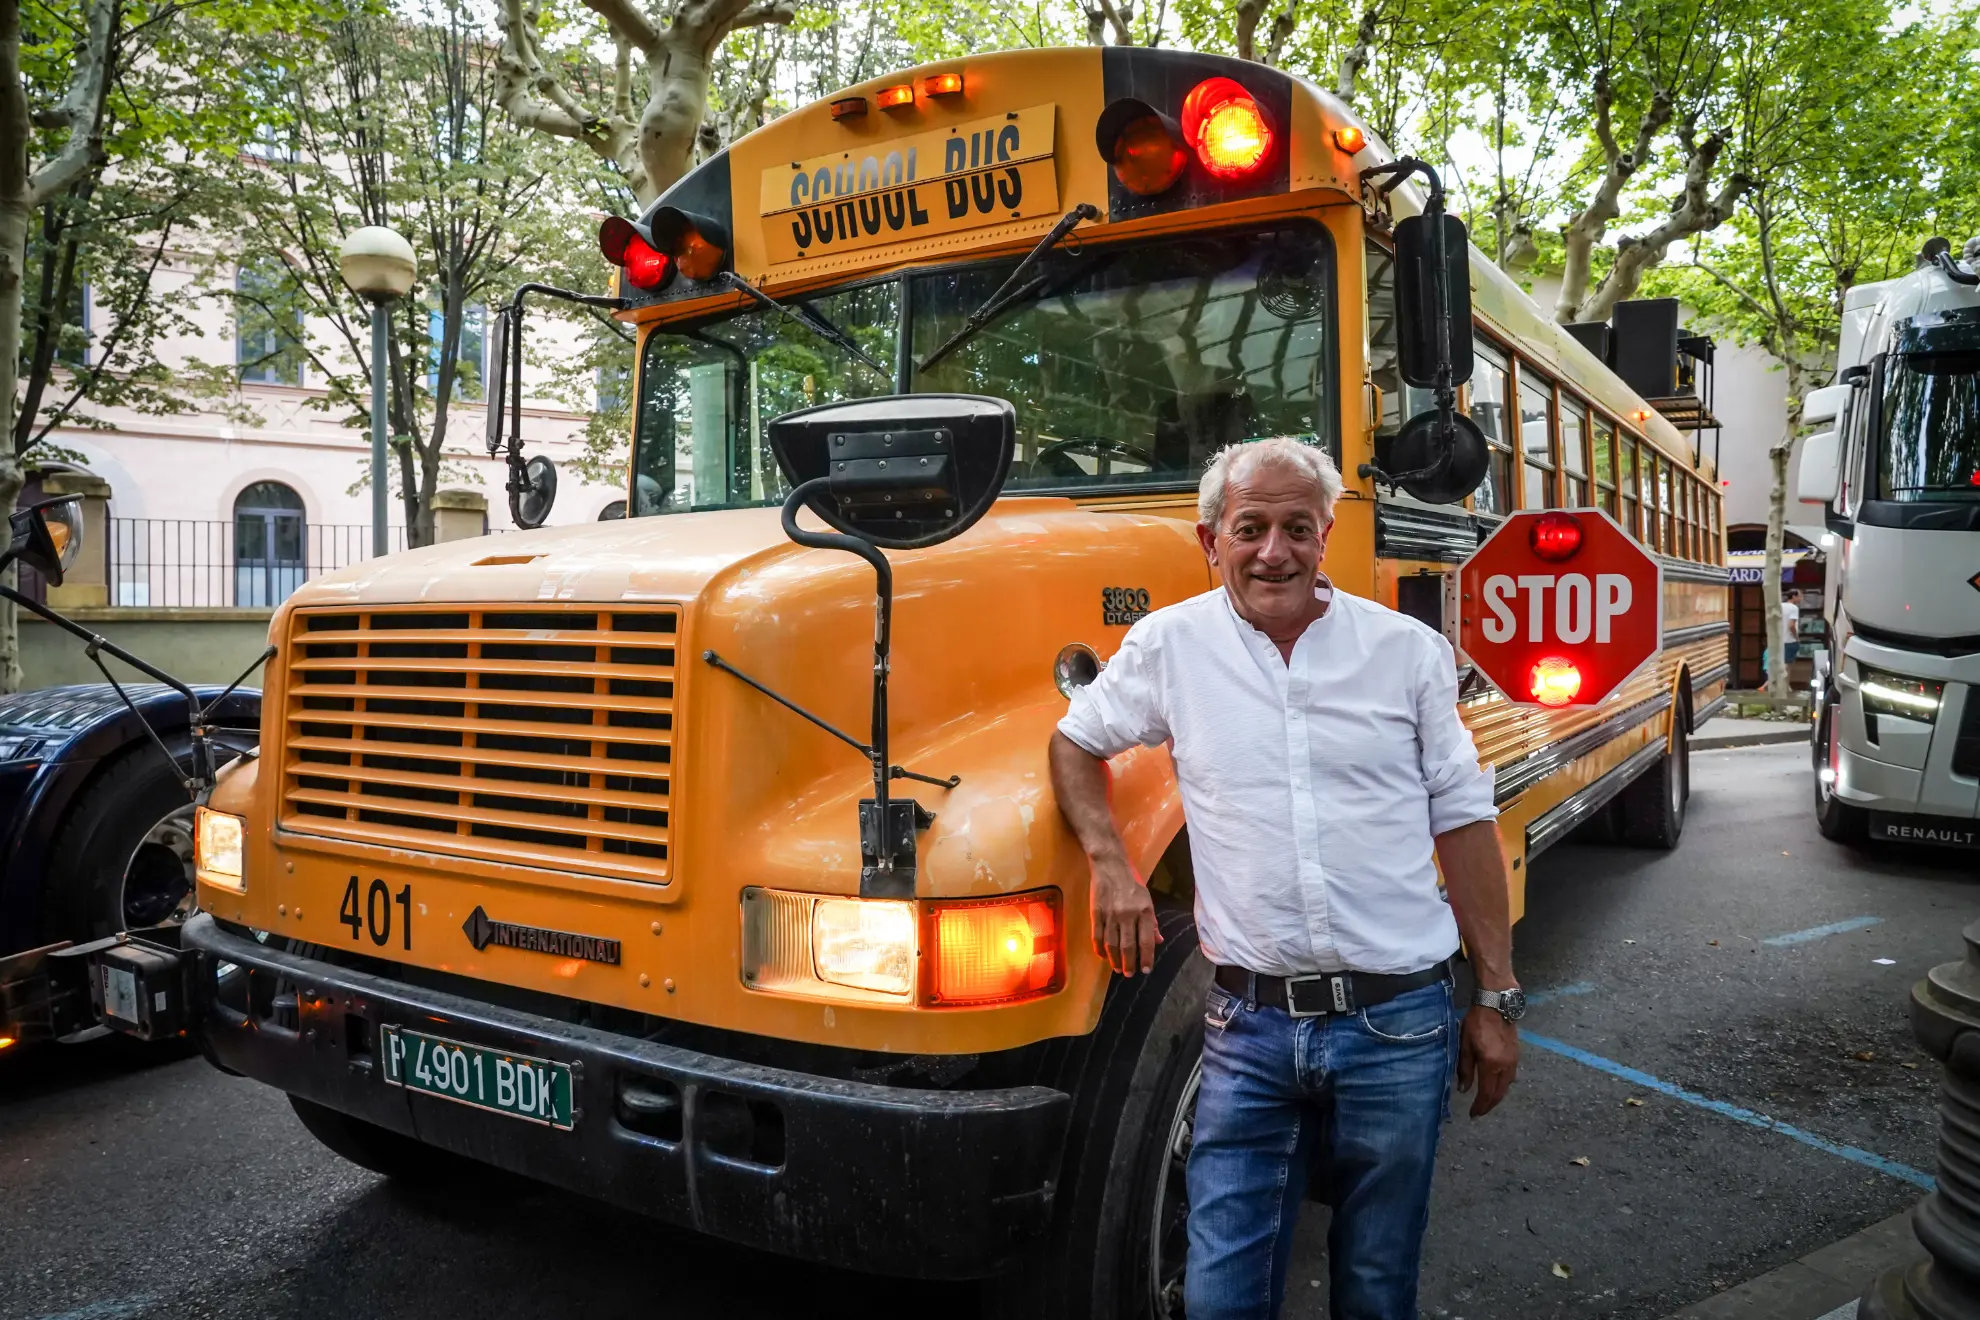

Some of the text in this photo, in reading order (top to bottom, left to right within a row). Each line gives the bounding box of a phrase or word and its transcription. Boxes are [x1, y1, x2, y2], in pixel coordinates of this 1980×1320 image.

[791, 124, 1022, 248] SCHOOL BUS
[1102, 587, 1150, 611] 3800
[1728, 567, 1764, 582] ARD
[1482, 573, 1633, 644] STOP
[1887, 825, 1975, 843] RENAULT
[340, 876, 411, 950] 401
[494, 923, 618, 963] INTERNATIONAL
[390, 1034, 558, 1119] P 4901 BDK
